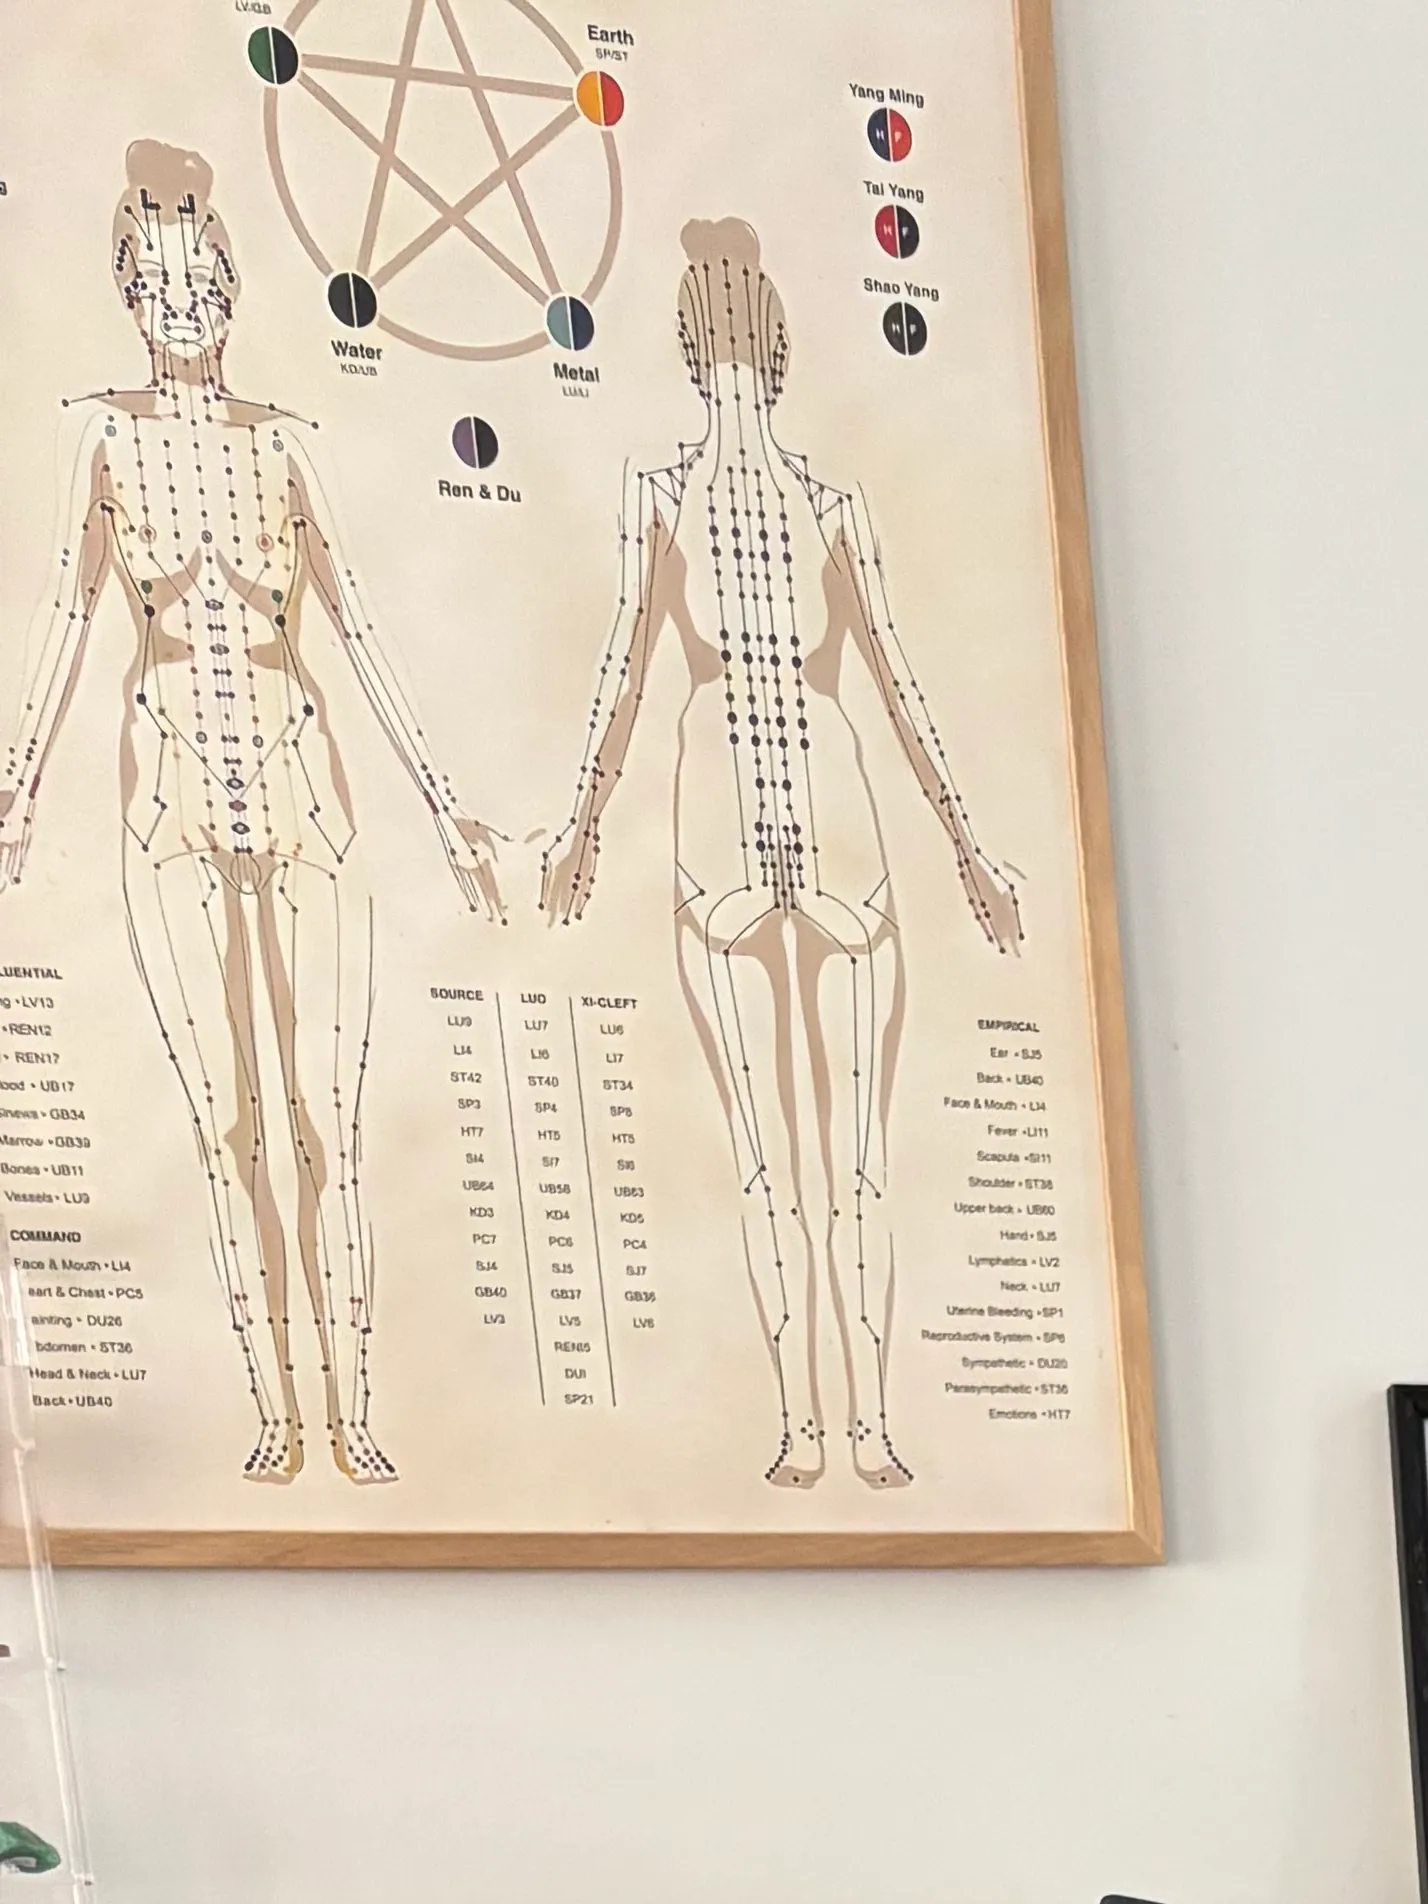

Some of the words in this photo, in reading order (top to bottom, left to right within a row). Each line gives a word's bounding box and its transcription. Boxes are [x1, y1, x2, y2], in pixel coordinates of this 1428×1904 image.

[587, 24, 634, 46] Earth
[849, 83, 885, 103] Yang
[889, 88, 925, 108] Ming
[863, 180, 884, 196] Tai
[889, 183, 925, 203] Yang
[863, 277, 901, 293] Shao
[904, 281, 940, 302] Yang
[331, 340, 382, 361] Water
[553, 362, 600, 383] Metal
[438, 479, 473, 499] Ren
[479, 484, 491, 500] &
[497, 485, 521, 503] Du
[430, 987, 484, 1001] SOURCE
[581, 996, 638, 1010] XI-CLEFT
[9, 1023, 52, 1037] REN12
[15, 1051, 60, 1065] REN17
[10, 1229, 81, 1243] COMMAND
[31, 1315, 73, 1329] ainting
[35, 1342, 86, 1353] bdomen
